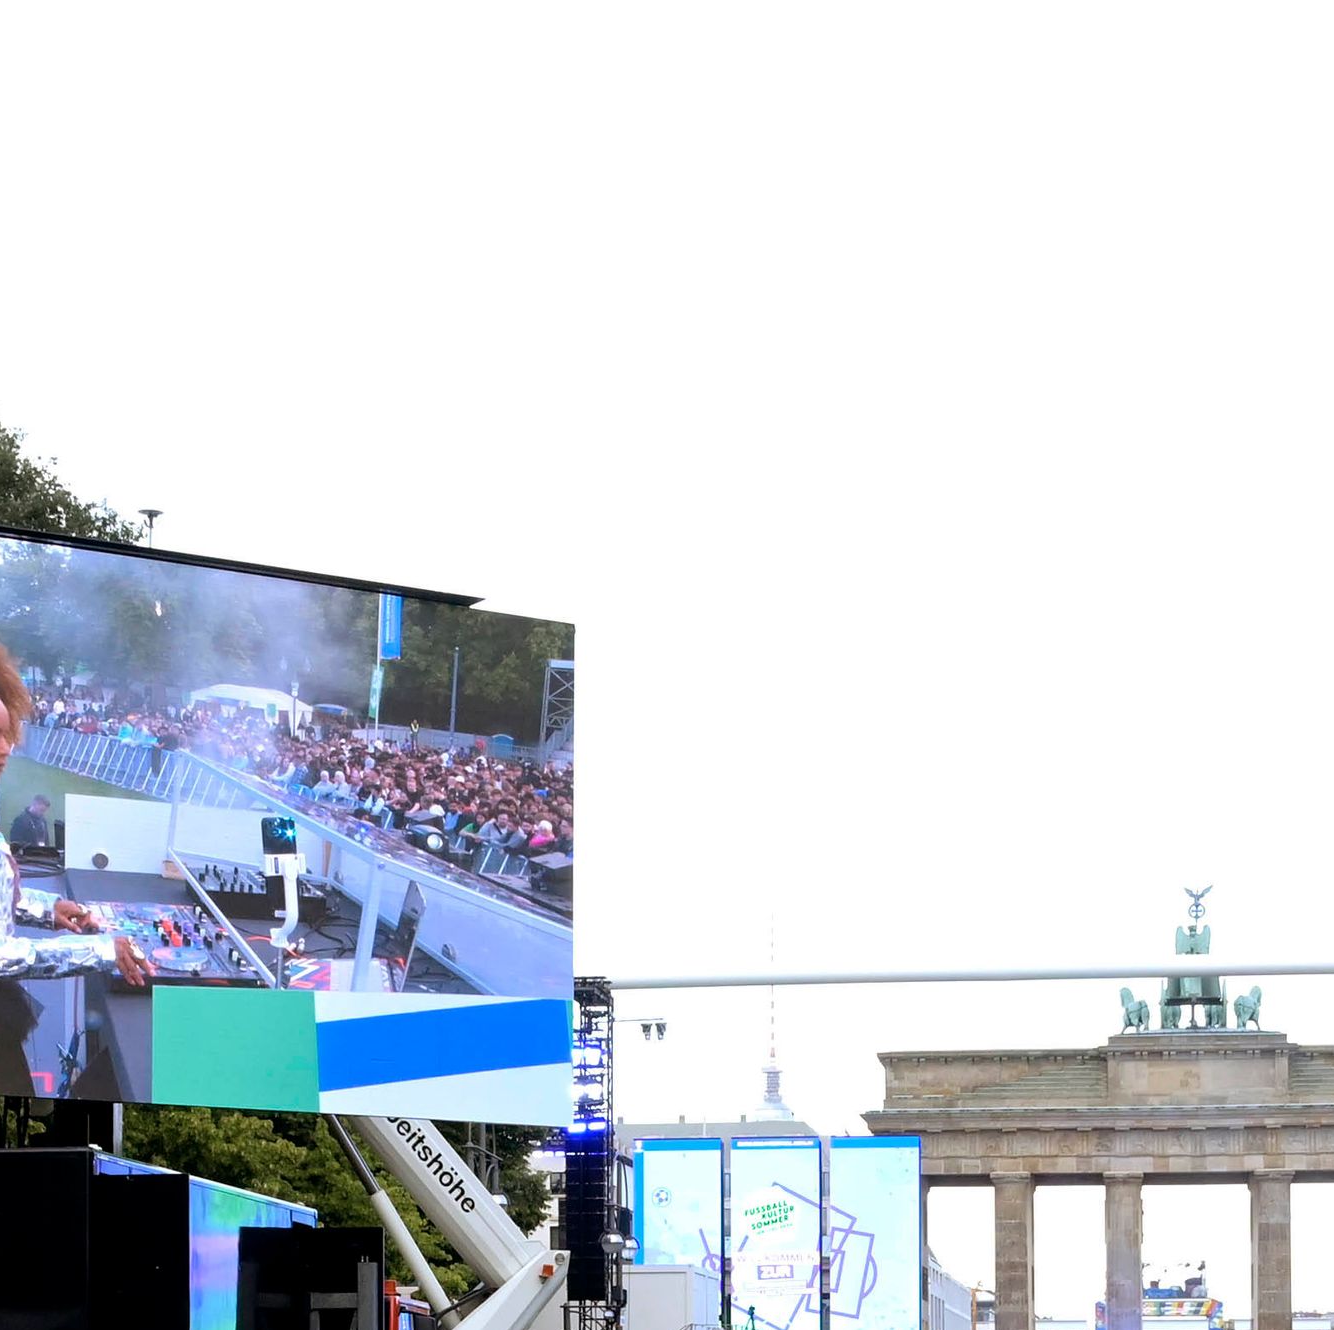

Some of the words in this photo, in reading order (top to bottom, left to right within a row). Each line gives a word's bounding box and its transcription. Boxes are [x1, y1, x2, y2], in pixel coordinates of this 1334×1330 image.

[744, 1200, 787, 1216] FUSSBALL
[761, 1205, 794, 1220] KULTUR
[751, 1214, 789, 1230] SOMMER
